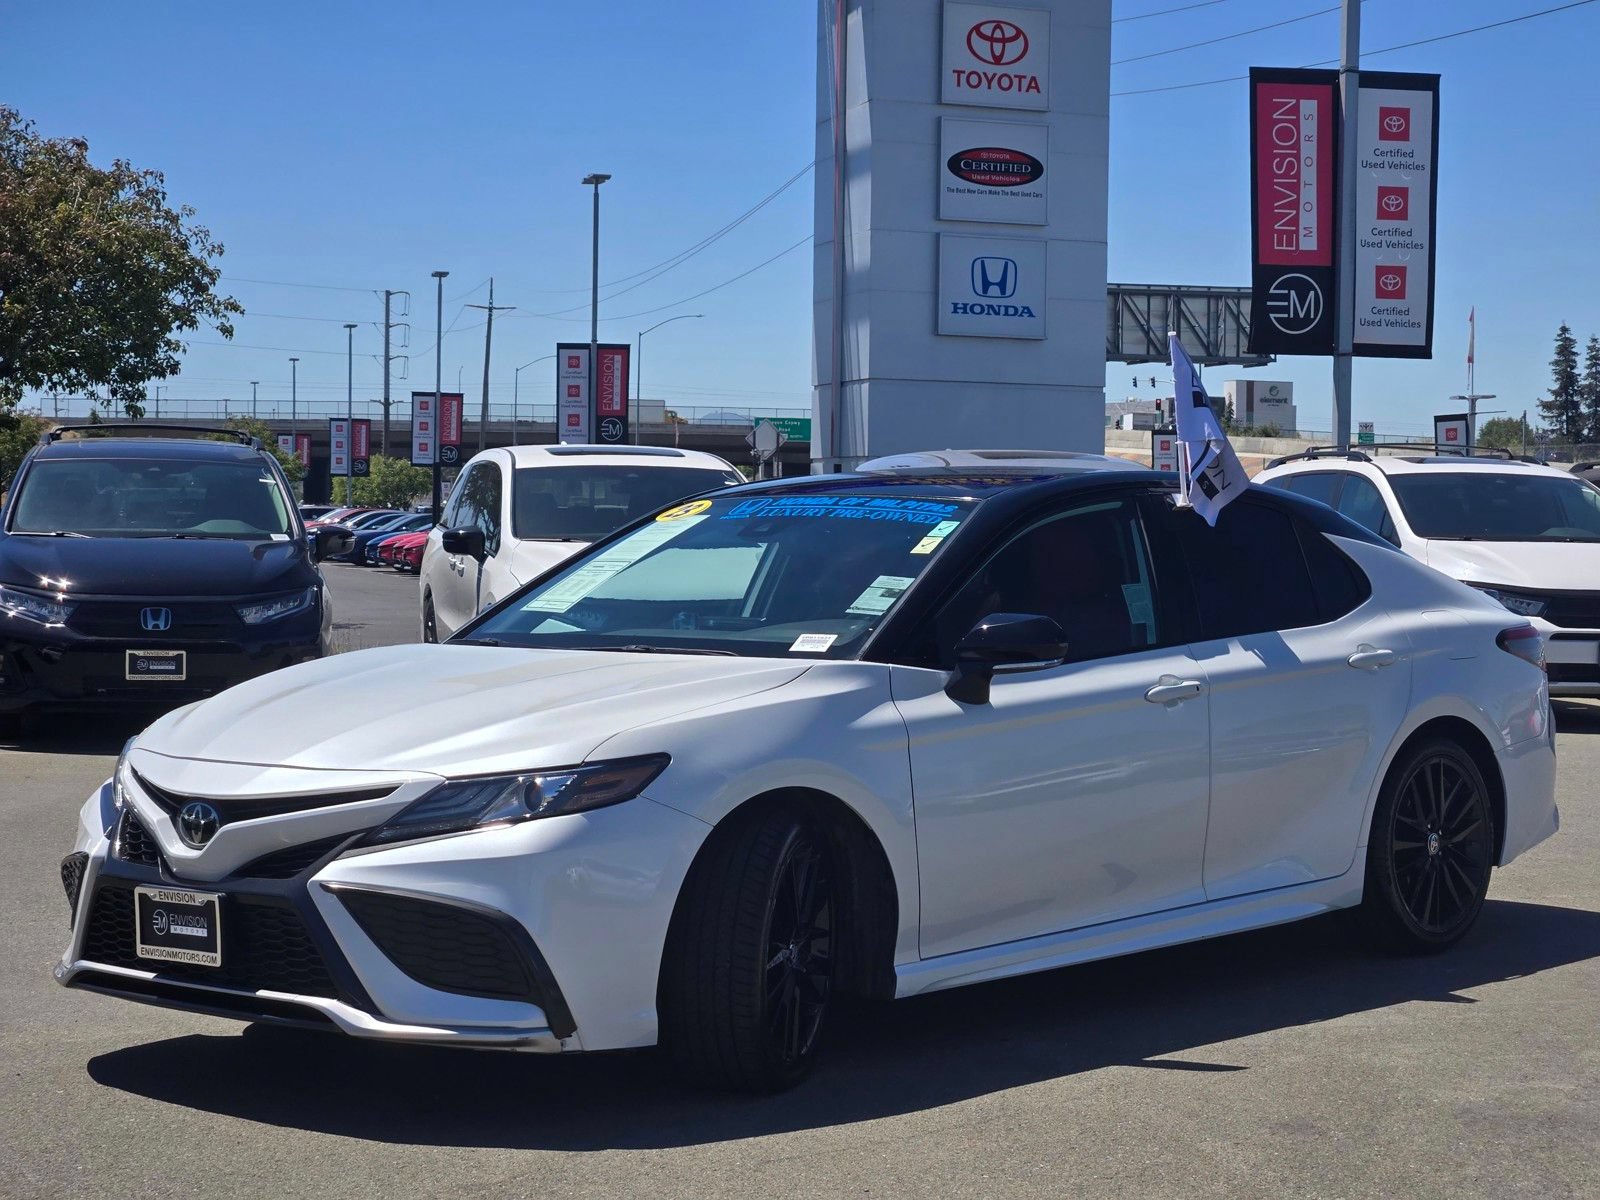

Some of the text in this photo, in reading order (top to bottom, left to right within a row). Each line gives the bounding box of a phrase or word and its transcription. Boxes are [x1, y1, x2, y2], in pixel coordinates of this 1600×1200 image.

[953, 69, 1041, 94] TOYOTA
[1373, 147, 1414, 158] Certified
[1361, 160, 1426, 171] Used Vehicles
[991, 174, 1020, 182] Vehicles
[1272, 98, 1298, 250] ENVISION
[1303, 113, 1314, 237] MOTORS
[1371, 227, 1413, 237] Certified
[1360, 239, 1424, 250] Used Vehicles
[951, 302, 1036, 318] HONDA
[1371, 306, 1410, 316] Certified
[1360, 317, 1422, 328] Used Vehicles
[602, 354, 614, 411] ENVISION
[756, 508, 943, 524] LUXURY PRE-OWNED
[158, 890, 196, 904] ENVISION
[169, 913, 208, 928] ENVISION
[140, 946, 218, 965] ENVISIONMOTORS.COM
